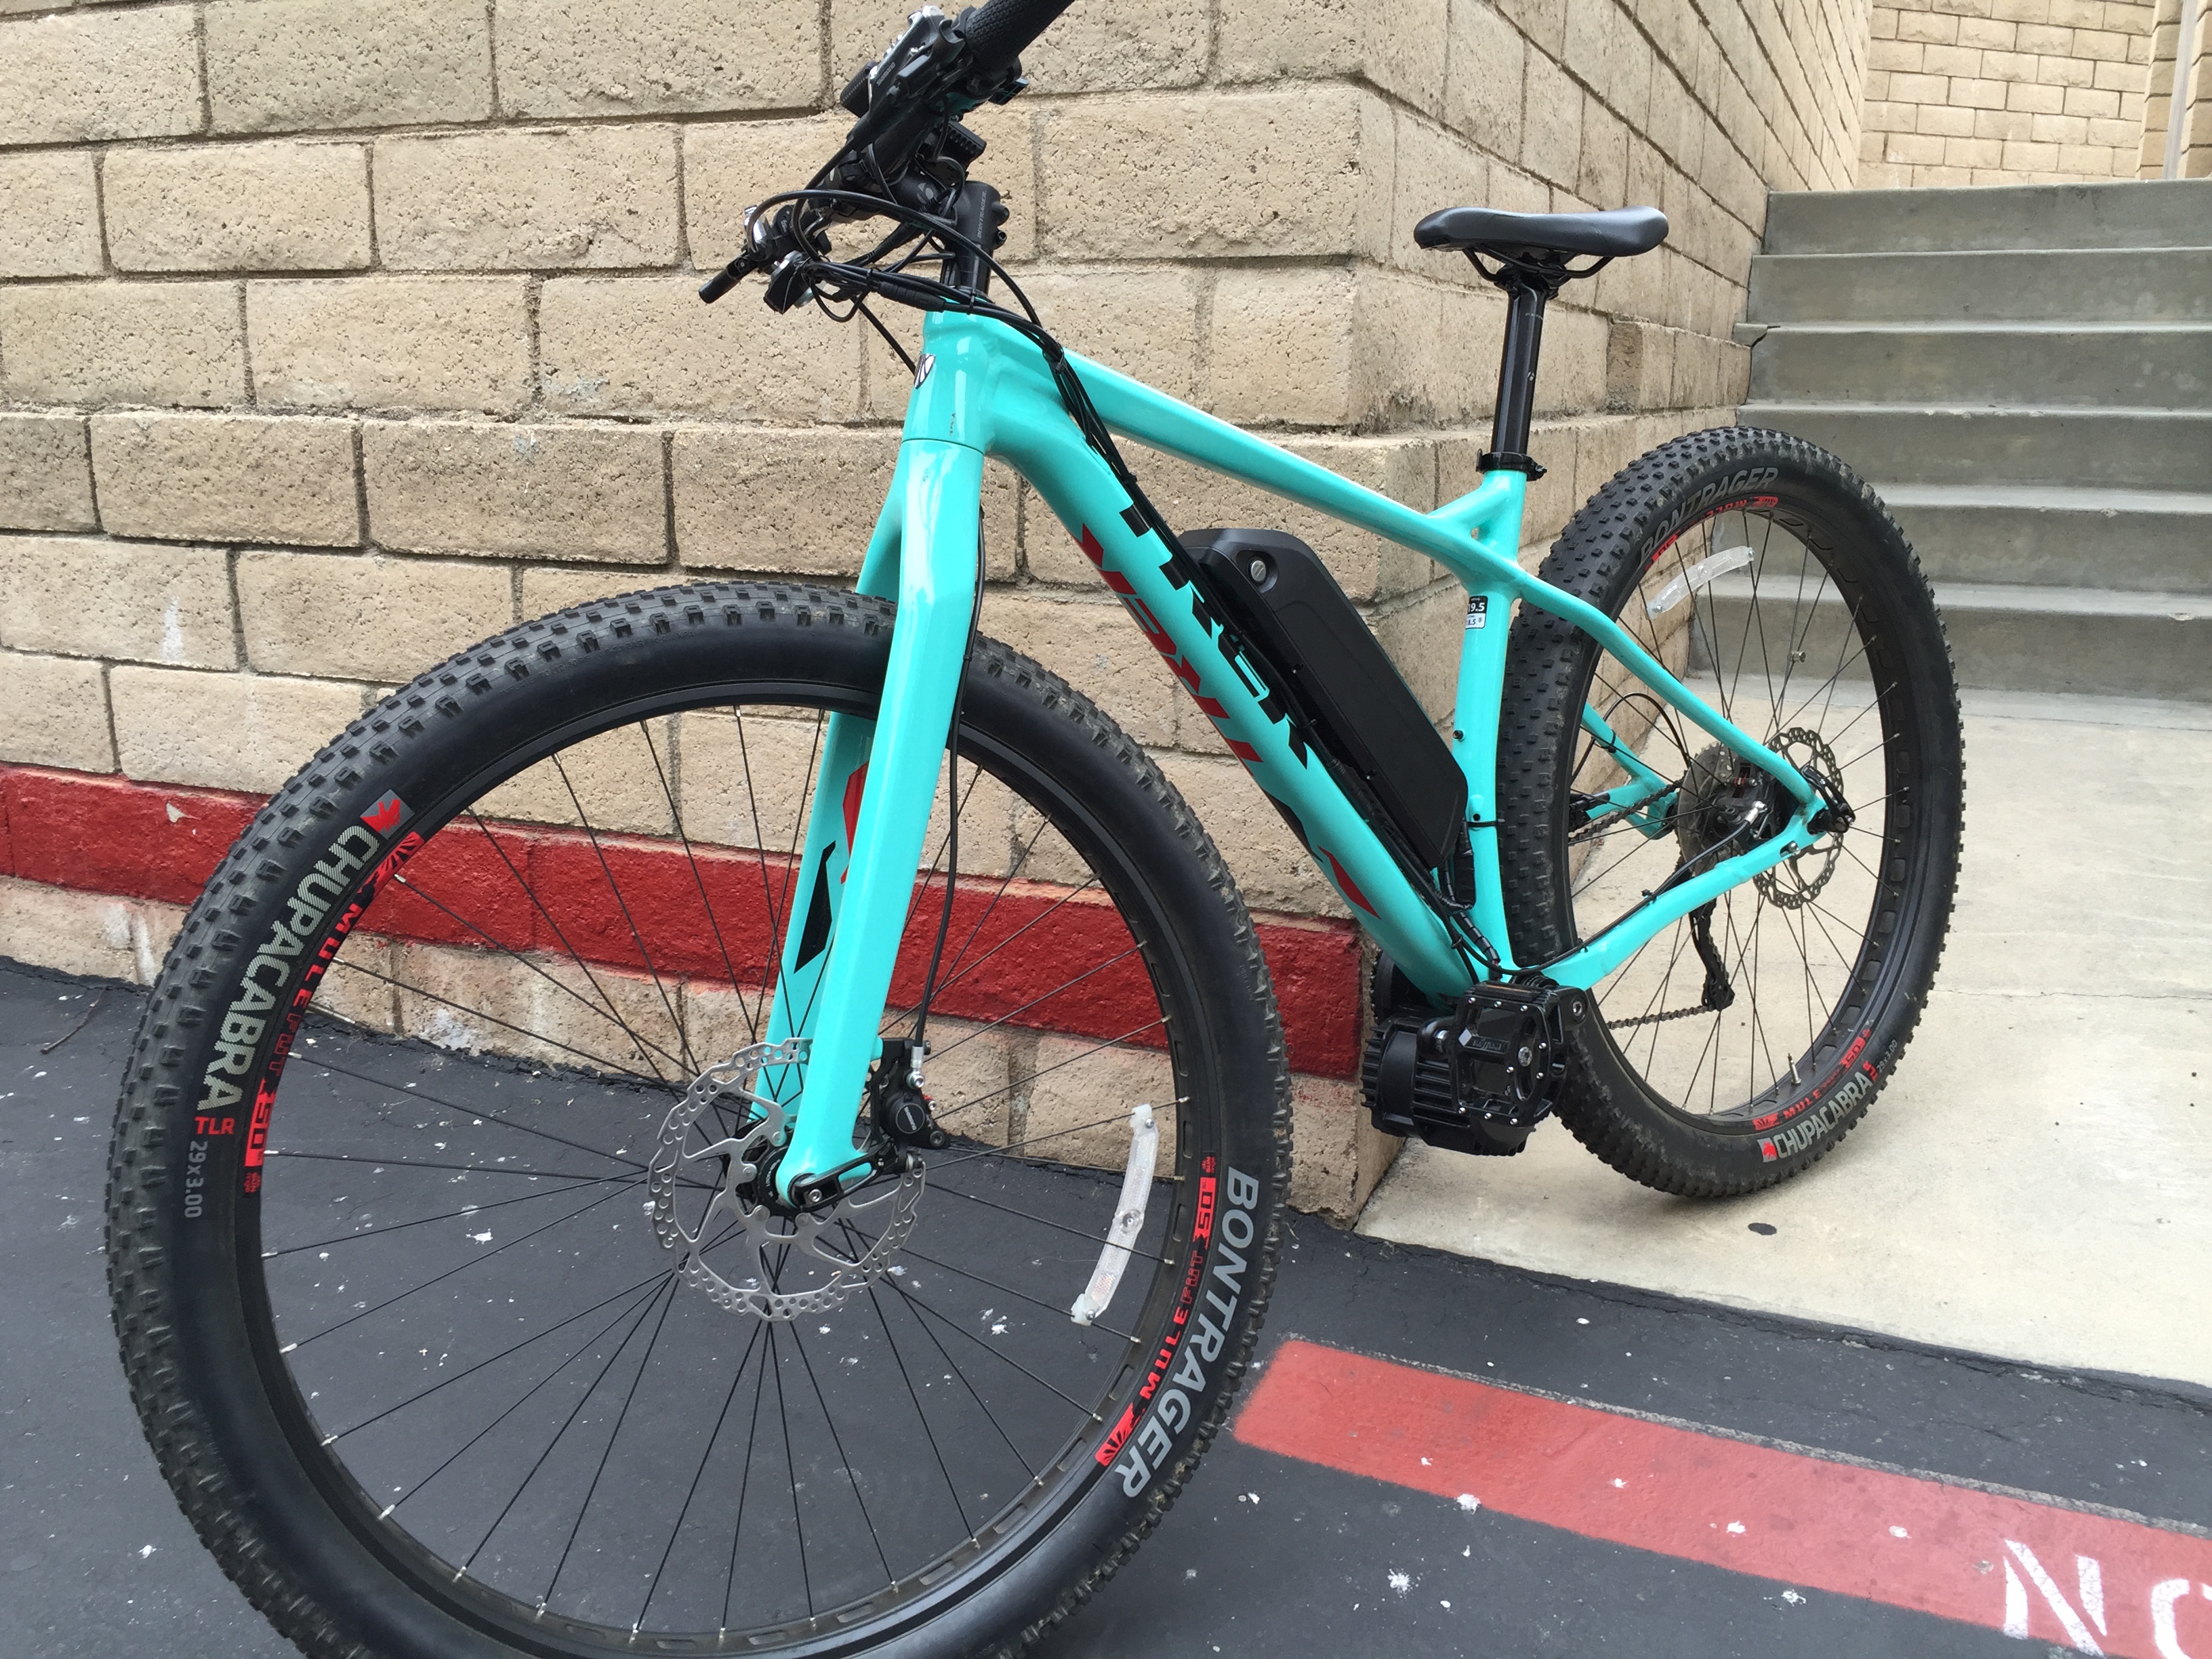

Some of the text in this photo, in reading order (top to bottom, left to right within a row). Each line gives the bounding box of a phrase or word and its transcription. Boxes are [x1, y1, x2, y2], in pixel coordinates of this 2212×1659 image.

[1638, 467, 1779, 564] BONTRAGER
[197, 825, 380, 1110] CHUPACABRA
[1877, 1039, 1898, 1073] 29x3.00
[194, 1116, 234, 1135] TLR
[1773, 1071, 1873, 1159] CHUPACABRA
[184, 1141, 209, 1218] 29x3.00
[1115, 1166, 1259, 1498] BONTRAGER
